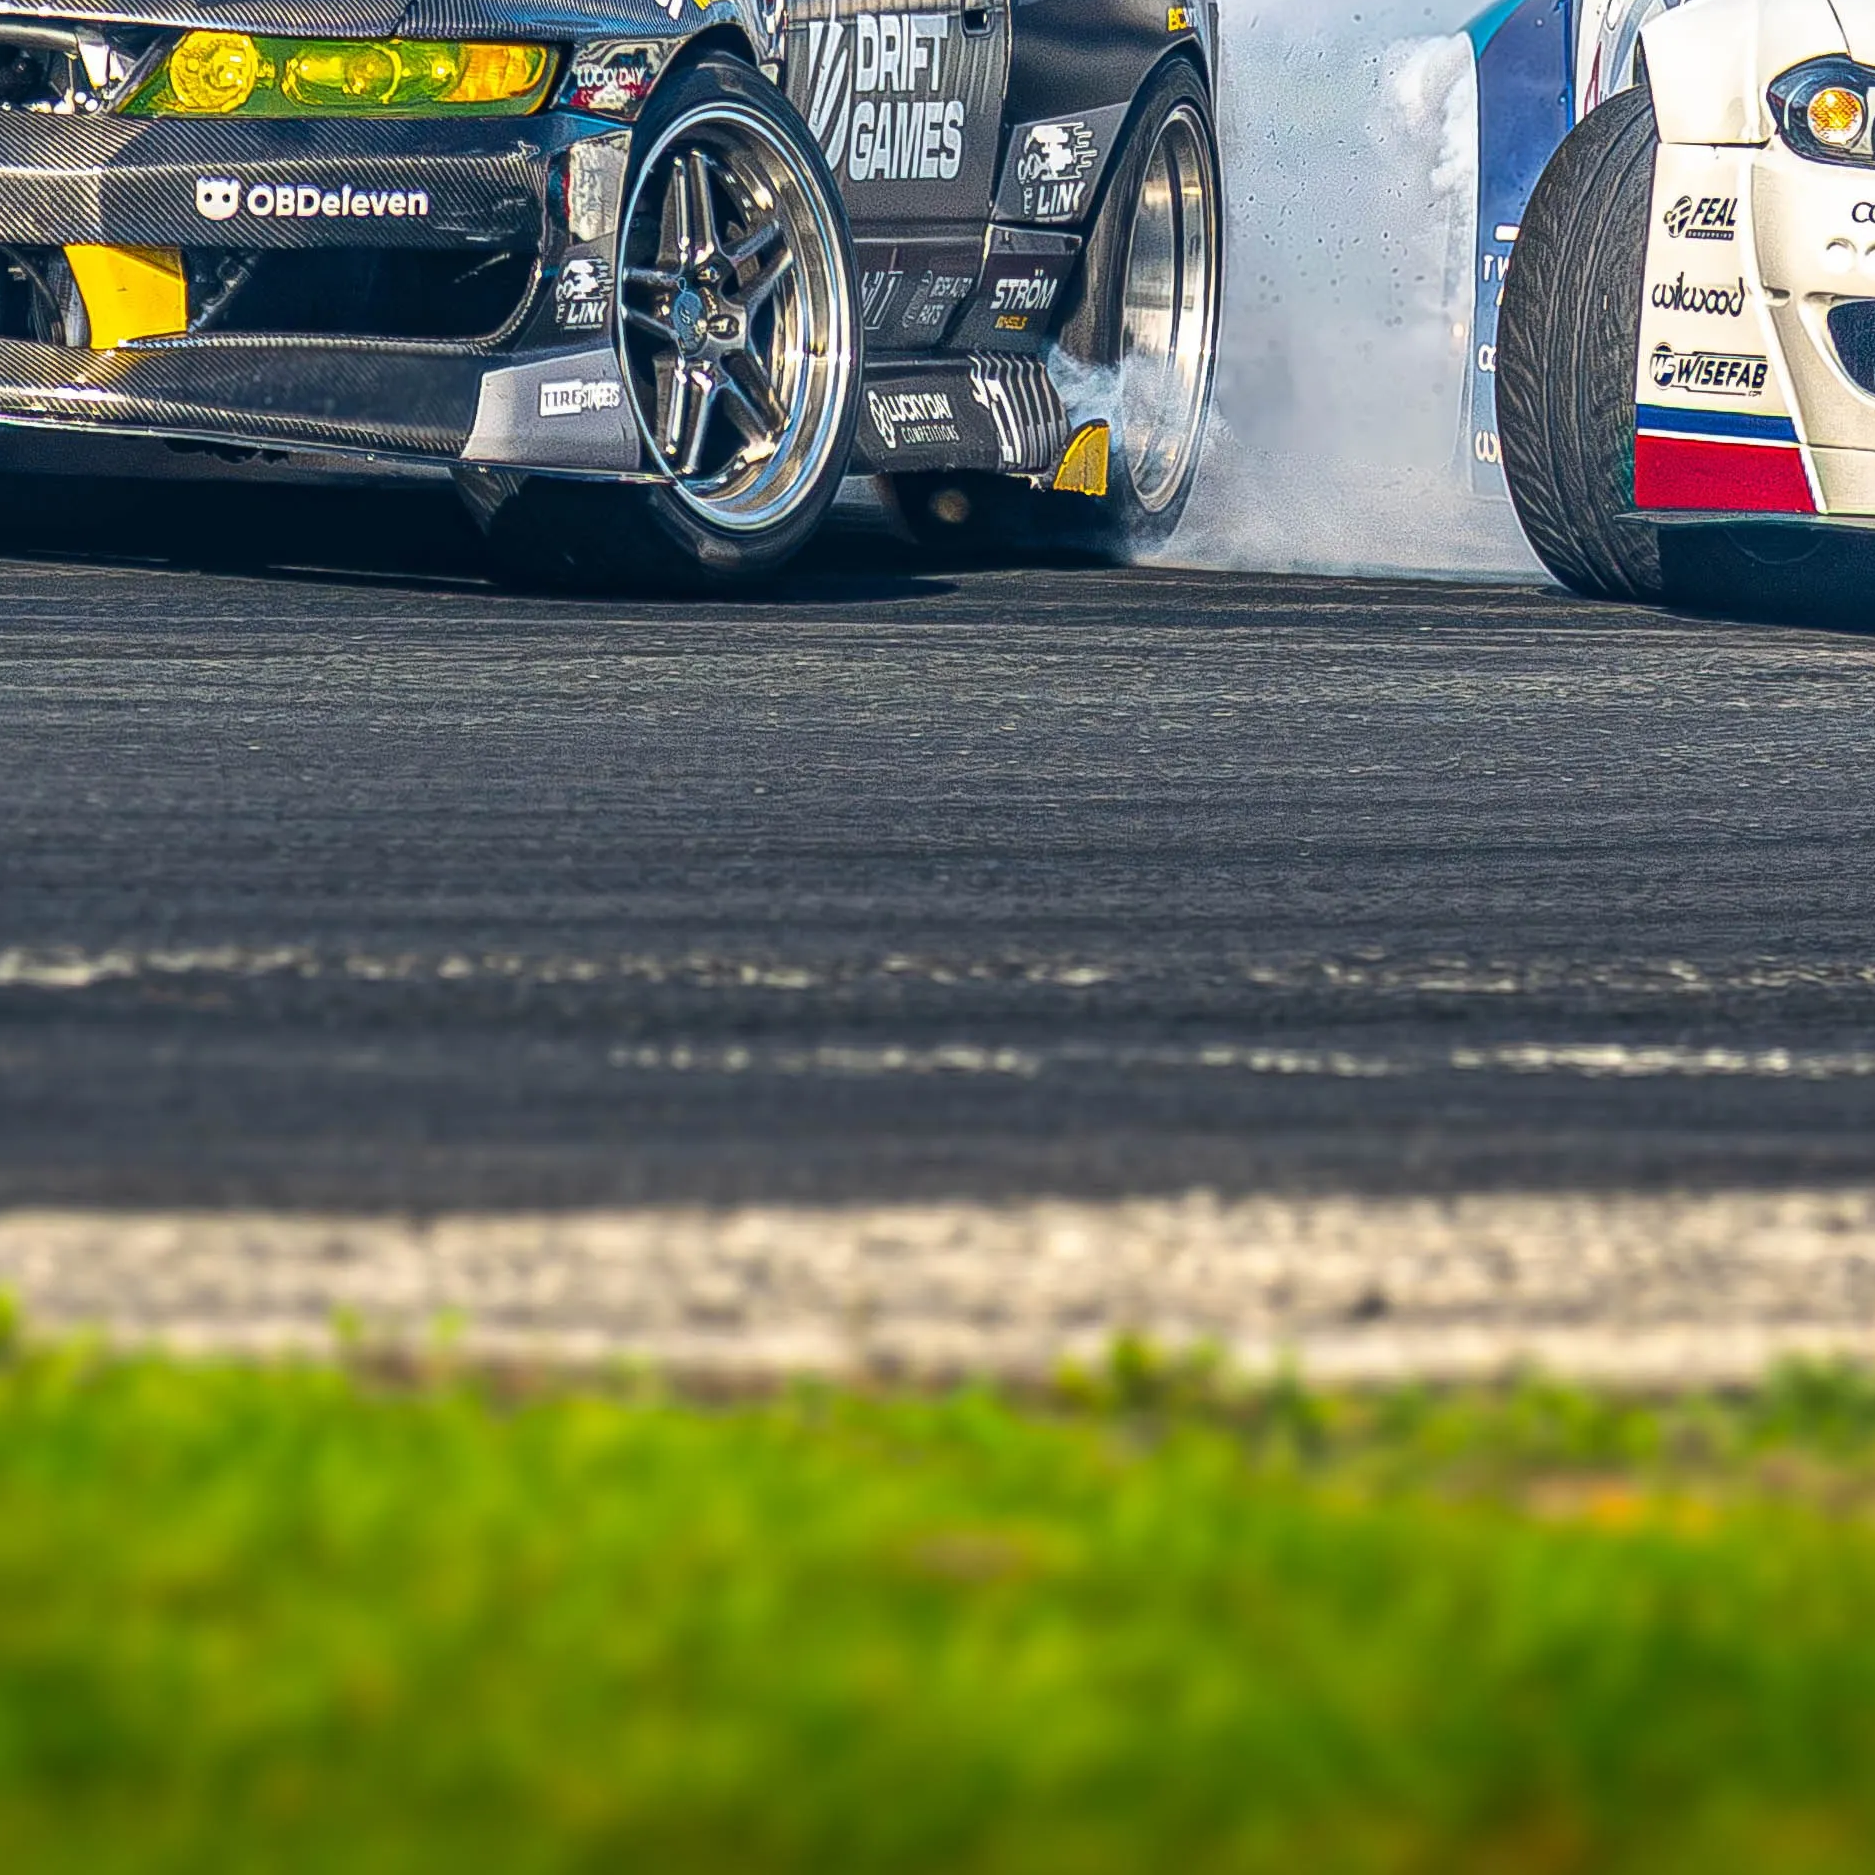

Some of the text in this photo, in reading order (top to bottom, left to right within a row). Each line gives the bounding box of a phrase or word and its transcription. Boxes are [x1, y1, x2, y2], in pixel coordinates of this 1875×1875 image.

[855, 13, 950, 93] DRIFT
[848, 100, 964, 182] GAMES
[246, 183, 430, 219] OBDeleven
[1690, 196, 1738, 228] FEAL
[989, 268, 1059, 310] STRÖM
[1651, 271, 1746, 318] wilwood
[1676, 358, 1768, 390] WISEFAB
